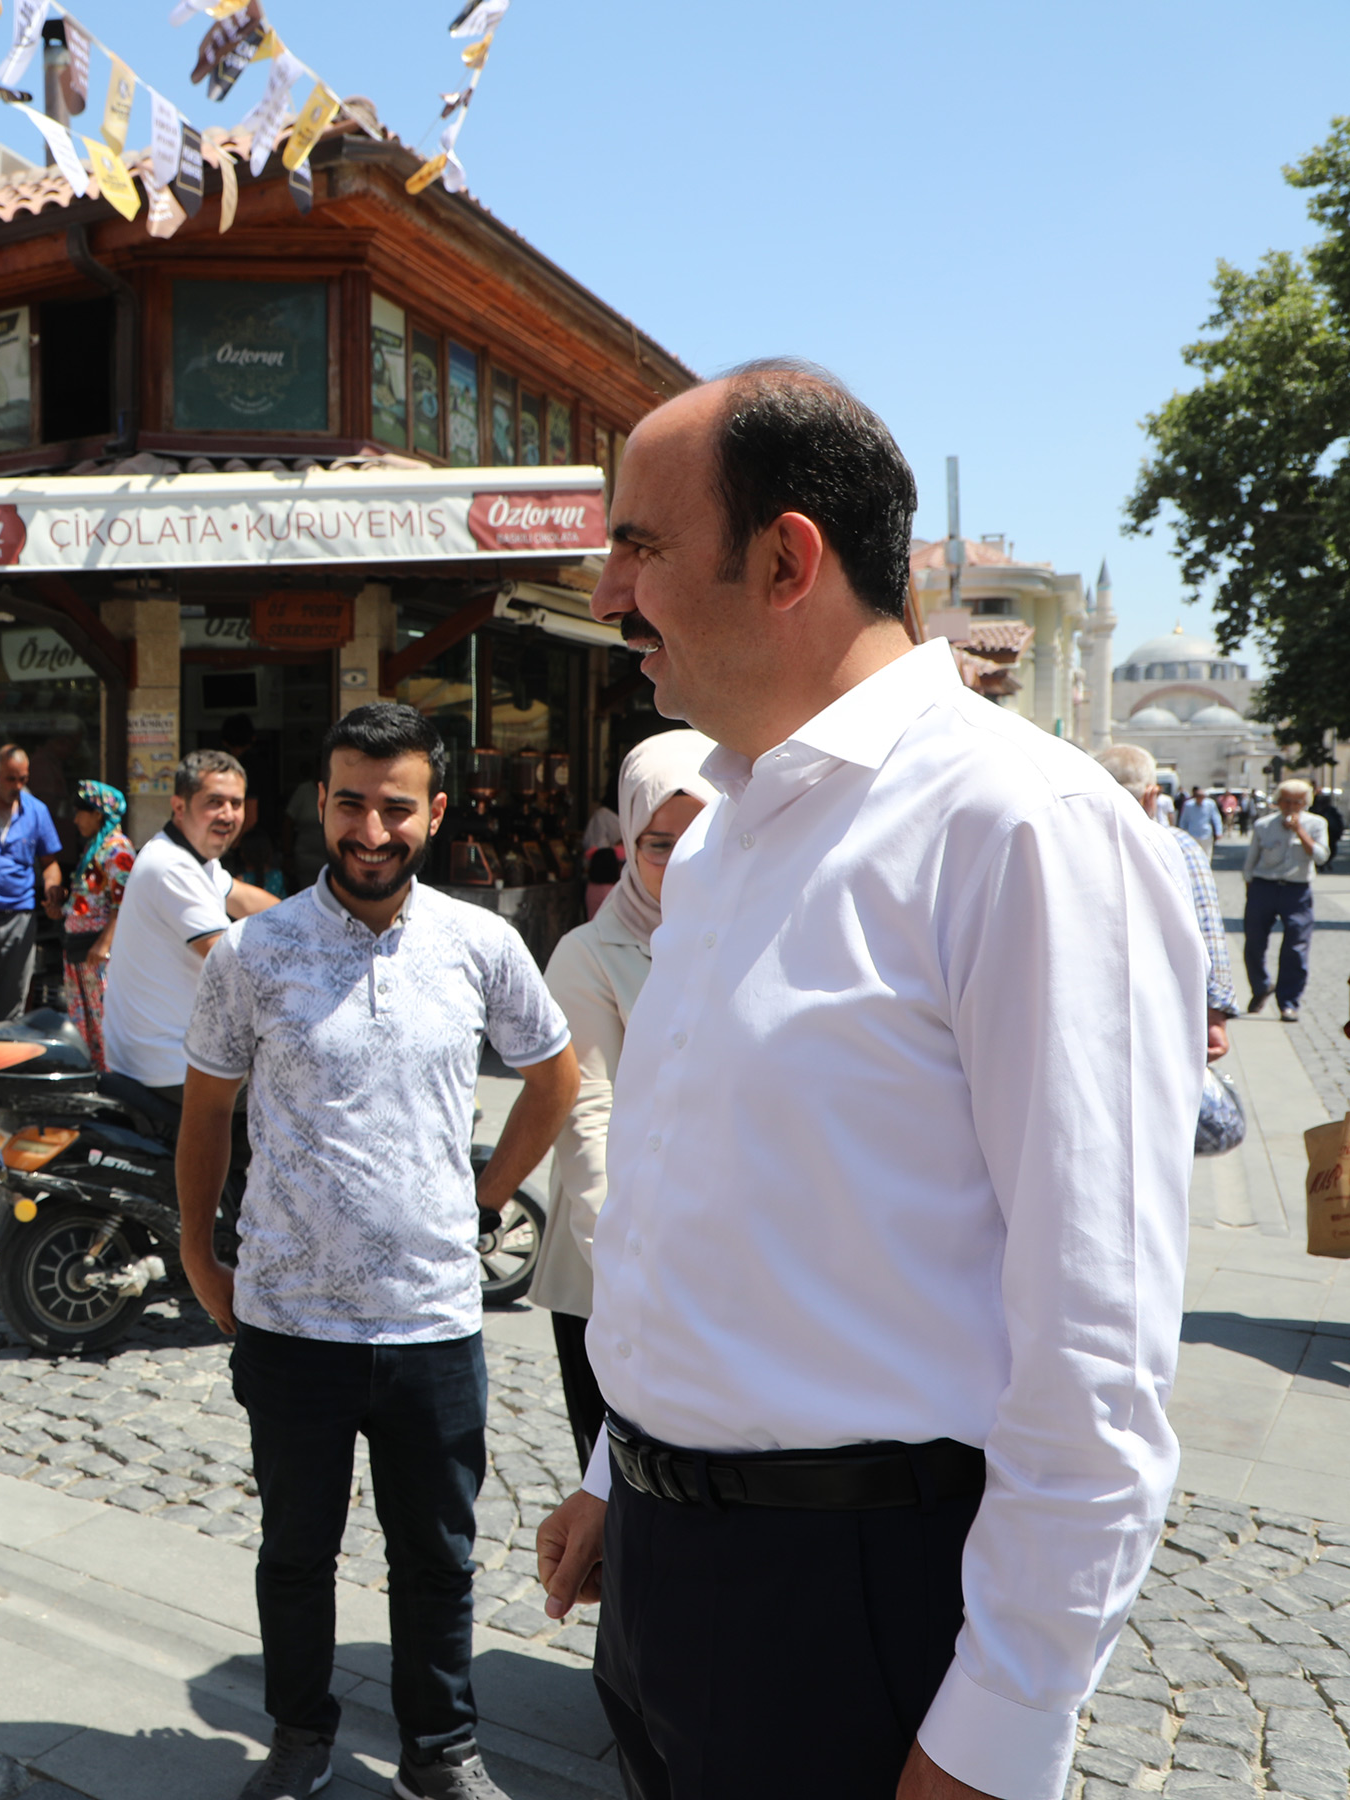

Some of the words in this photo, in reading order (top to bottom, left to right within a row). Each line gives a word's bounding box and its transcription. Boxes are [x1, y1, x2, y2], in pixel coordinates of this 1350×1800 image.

[216, 342, 285, 367] Öztorun
[50, 514, 222, 553] ÇİKOLATA
[246, 504, 446, 542] KURUYEMİŞ
[488, 495, 586, 529] Öztorun
